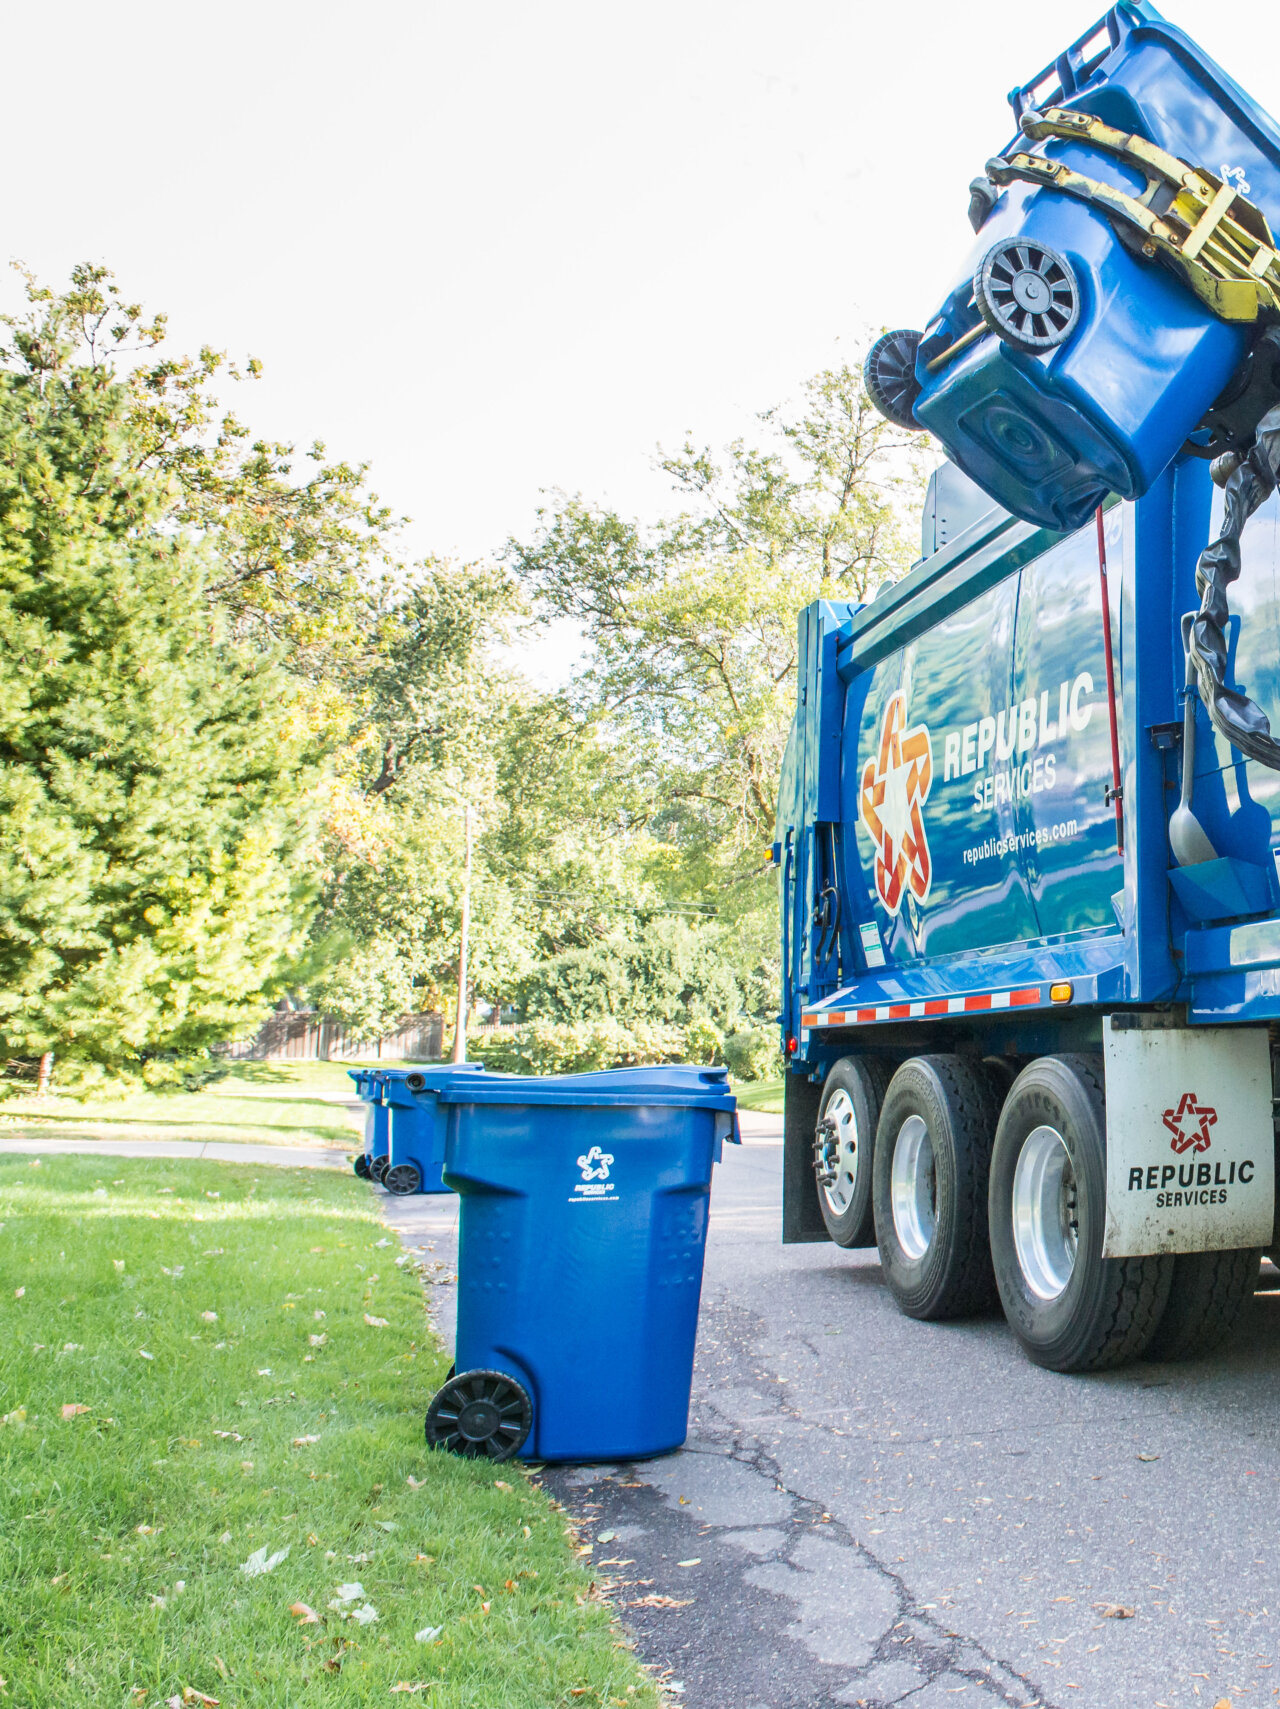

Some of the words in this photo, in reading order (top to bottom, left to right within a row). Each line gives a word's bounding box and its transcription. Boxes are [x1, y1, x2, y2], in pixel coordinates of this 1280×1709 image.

[944, 672, 1094, 782] REPUBLIC
[974, 754, 1056, 813] SERVICES
[963, 819, 1077, 866] republicservices.com
[1128, 1160, 1255, 1191] REPUBLIC
[1156, 1189, 1228, 1209] SERVICES
